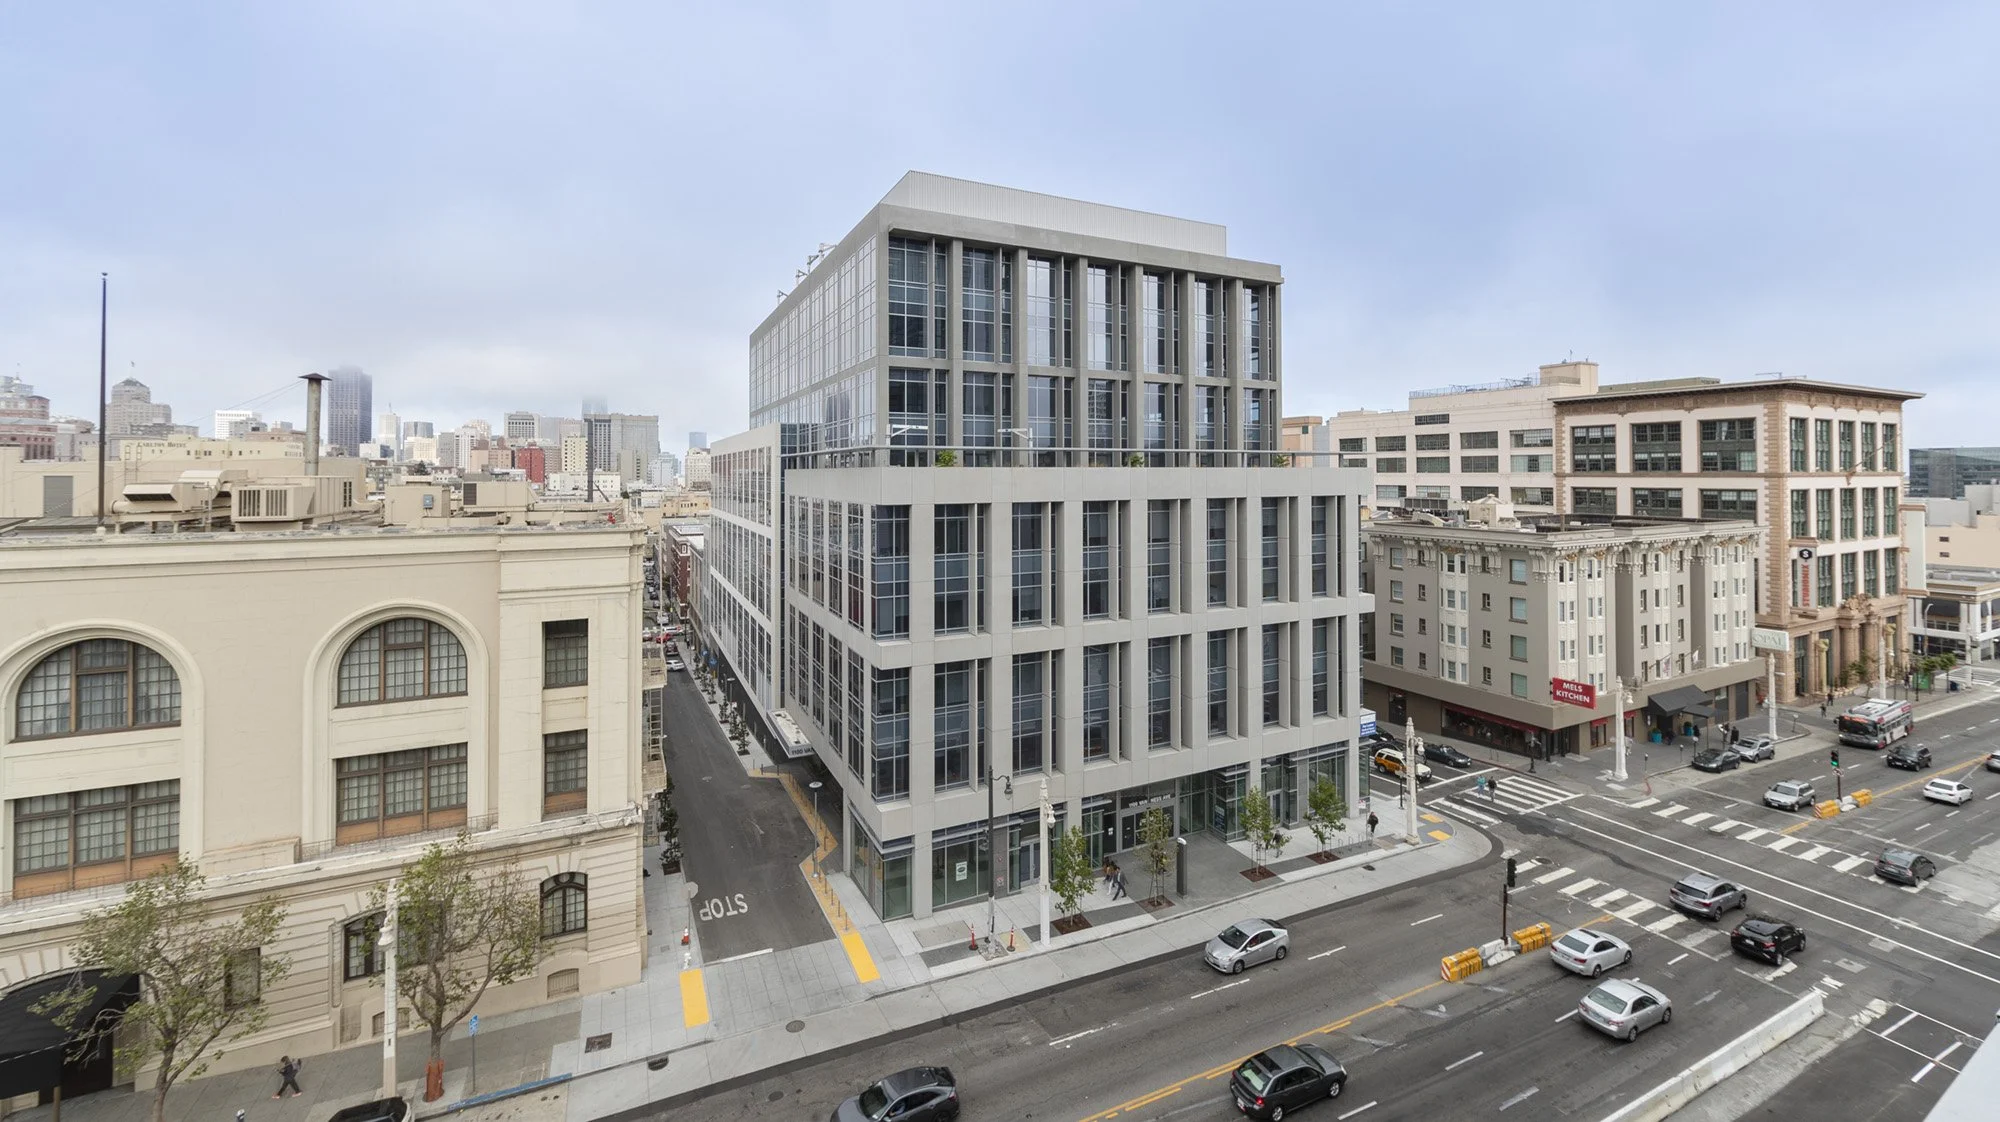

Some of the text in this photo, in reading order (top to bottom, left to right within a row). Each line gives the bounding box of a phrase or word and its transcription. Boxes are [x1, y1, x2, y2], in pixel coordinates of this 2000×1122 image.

[1563, 682, 1583, 692] MELS
[1556, 689, 1590, 703] KITCHEN
[699, 893, 749, 921] STOP
